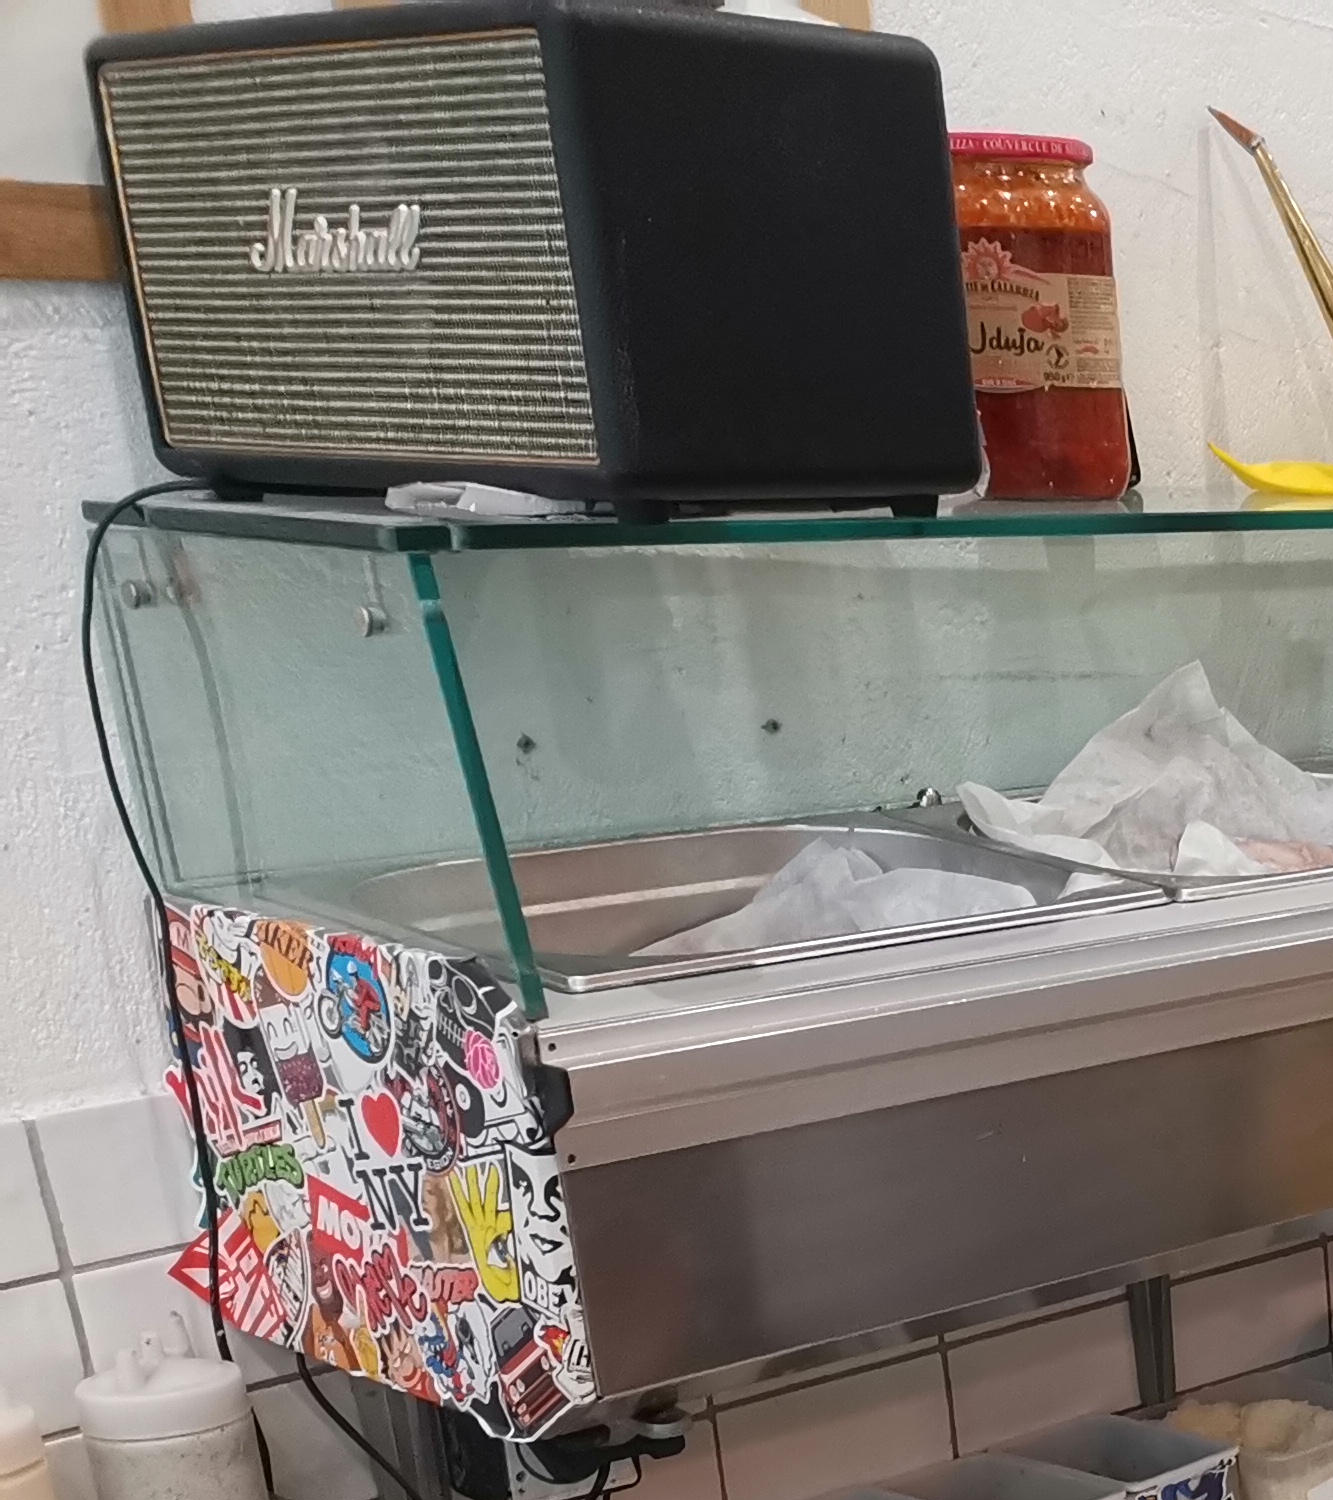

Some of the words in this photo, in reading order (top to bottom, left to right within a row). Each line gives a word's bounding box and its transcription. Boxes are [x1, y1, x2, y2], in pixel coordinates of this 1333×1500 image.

[249, 187, 422, 273] Marshall
[338, 1097, 370, 1160] I
[217, 1143, 305, 1202] TURTLES
[356, 1162, 430, 1232] NY
